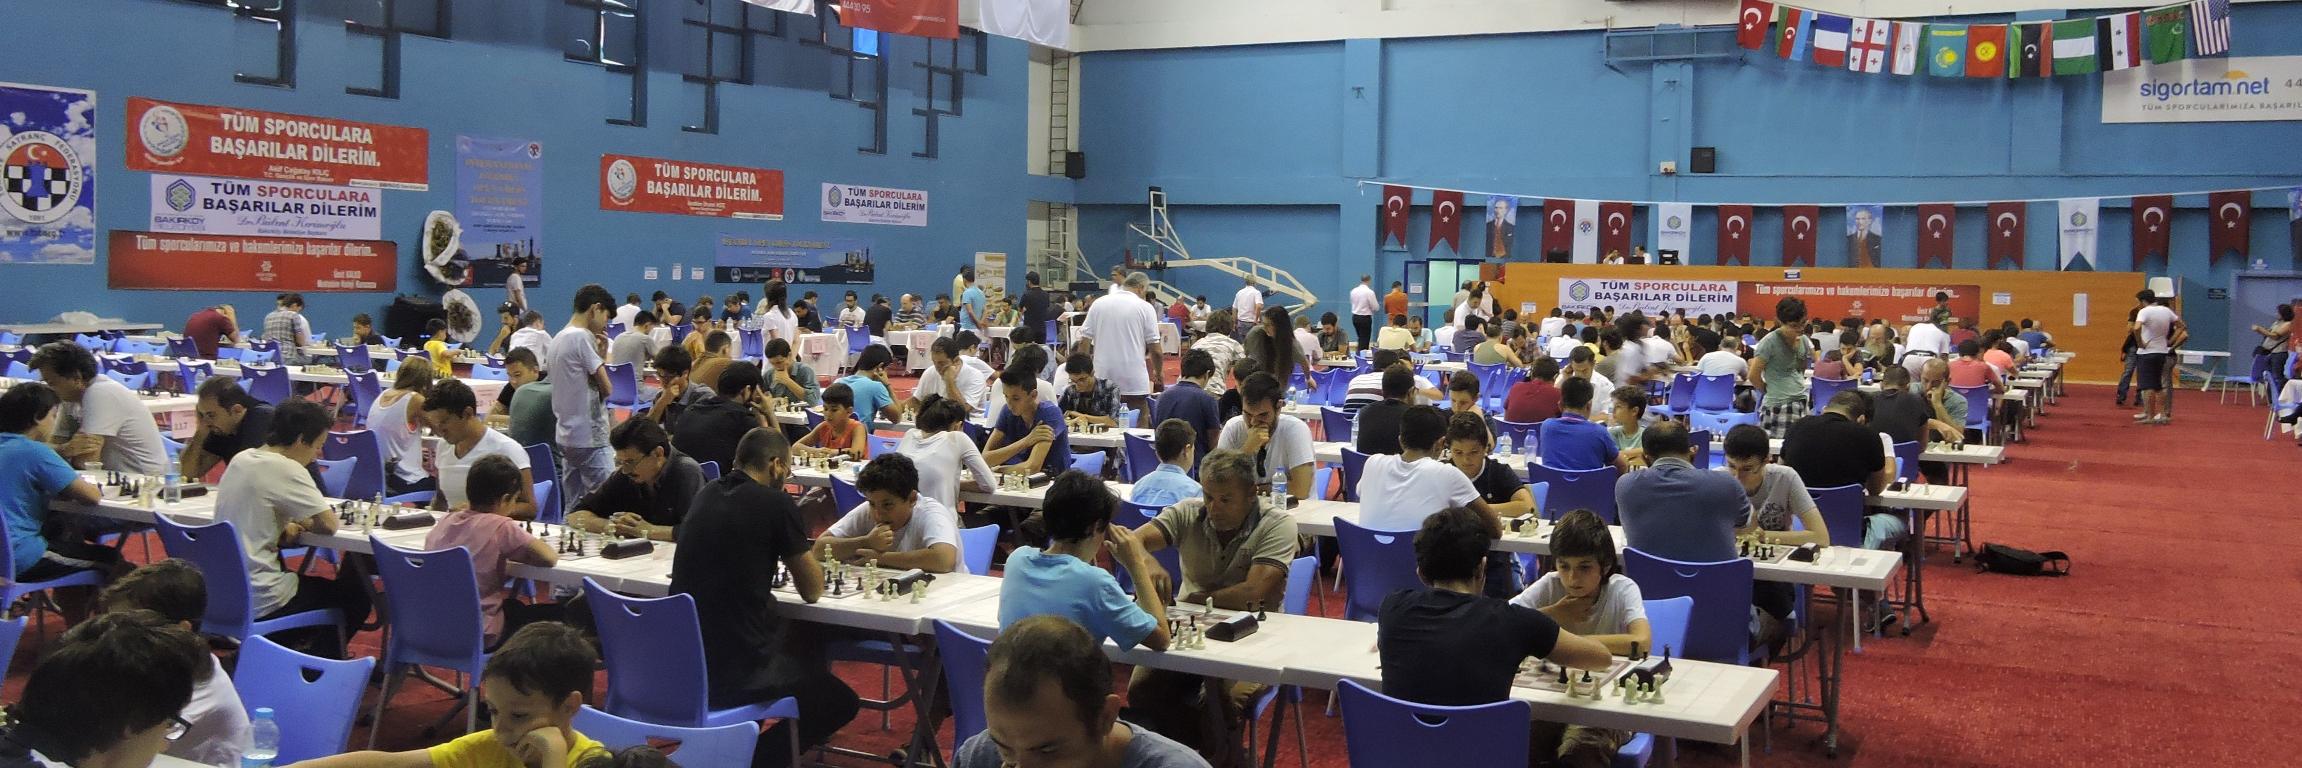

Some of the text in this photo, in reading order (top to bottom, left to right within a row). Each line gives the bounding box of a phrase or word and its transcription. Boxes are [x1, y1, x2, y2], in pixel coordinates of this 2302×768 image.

[2140, 77, 2270, 101] sigortam.net
[220, 111, 373, 145] TÜM SPORCULARA
[210, 136, 309, 160] BAŞARILAR
[312, 143, 381, 167] DİLERİM.
[655, 161, 757, 185] TÜM SPORCULARA
[211, 180, 251, 197] TÜM
[256, 185, 371, 203] SPORCULARA
[646, 180, 763, 202] BAŞARILAR DİLERİM.
[847, 186, 923, 201] TÜM SPORCULARA
[203, 197, 377, 218] BAŞARILAR DİLERİM
[844, 197, 926, 211] BAŞARILAR DİLERİM
[136, 234, 157, 250] Tüm
[1600, 279, 1728, 292] TÜM SPORCULARA
[1755, 283, 1771, 295] Tüm
[1826, 286, 1835, 296] ve
[1594, 291, 1733, 303] BAŞARILAR DİLERİM
